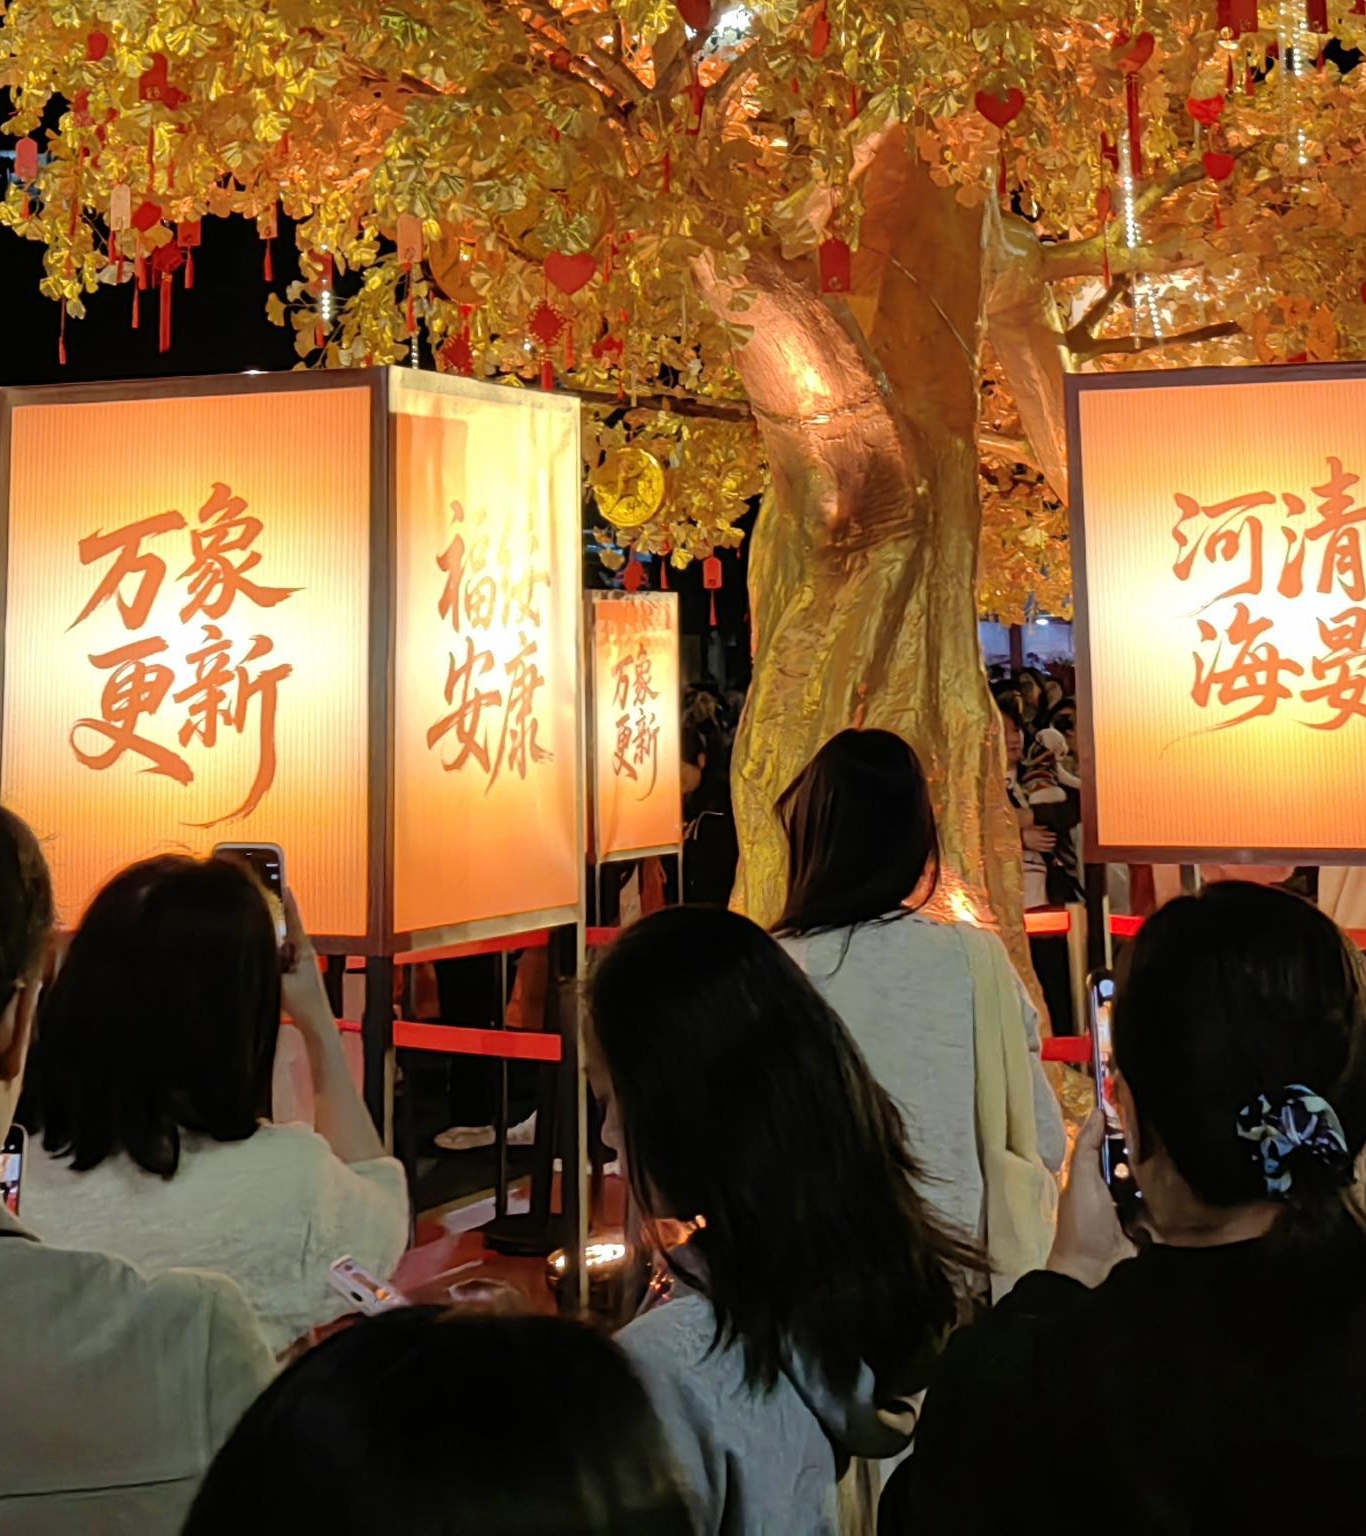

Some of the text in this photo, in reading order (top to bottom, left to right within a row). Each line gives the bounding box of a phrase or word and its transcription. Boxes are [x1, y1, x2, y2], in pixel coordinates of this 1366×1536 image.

[66, 482, 306, 632] 万象
[68, 624, 294, 828] 更新
[426, 631, 554, 797] 安康
